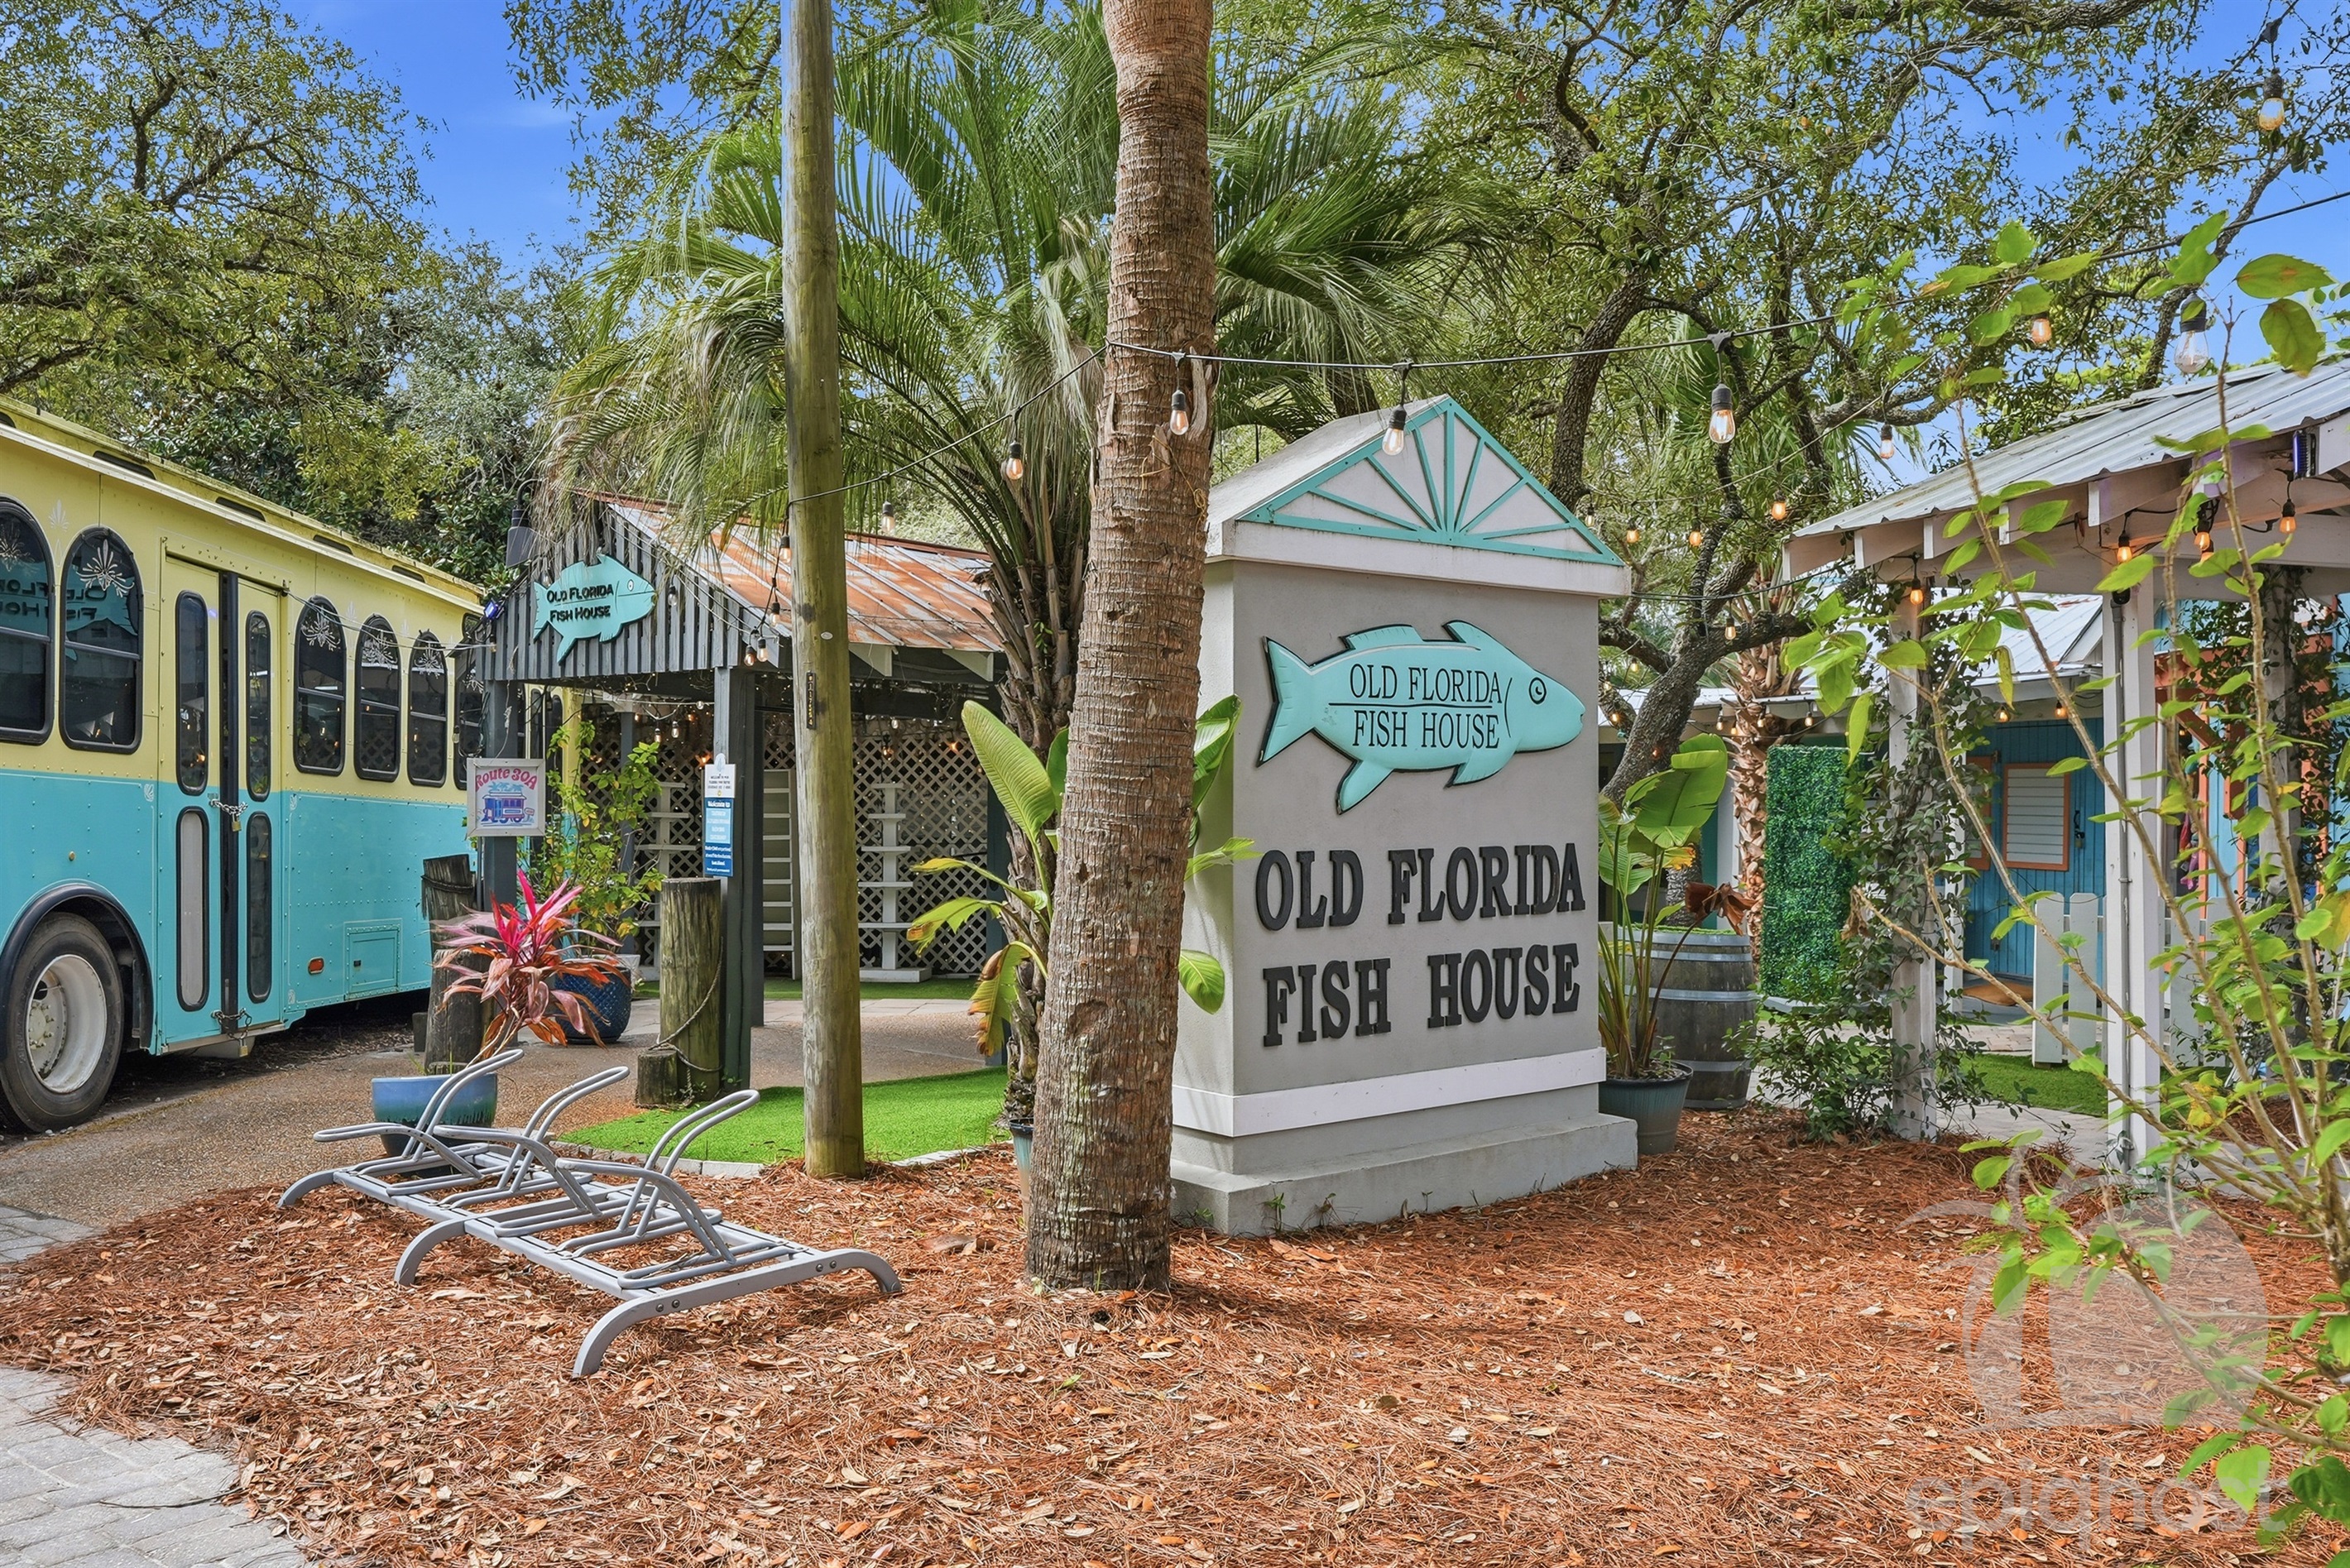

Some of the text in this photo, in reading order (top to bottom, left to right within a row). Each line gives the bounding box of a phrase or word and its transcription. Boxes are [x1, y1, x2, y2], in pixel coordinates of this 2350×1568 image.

[546, 584, 614, 603] OLD FLORIDA
[549, 605, 611, 622] FISH HOUSE
[1350, 664, 1503, 703] OLD FLORIDA
[1352, 710, 1500, 749] FISH HOUSE
[476, 769, 538, 792] Route 30A
[1255, 842, 1586, 932] OLD FLORIDA
[1263, 942, 1580, 1047] FISH HOUSE
